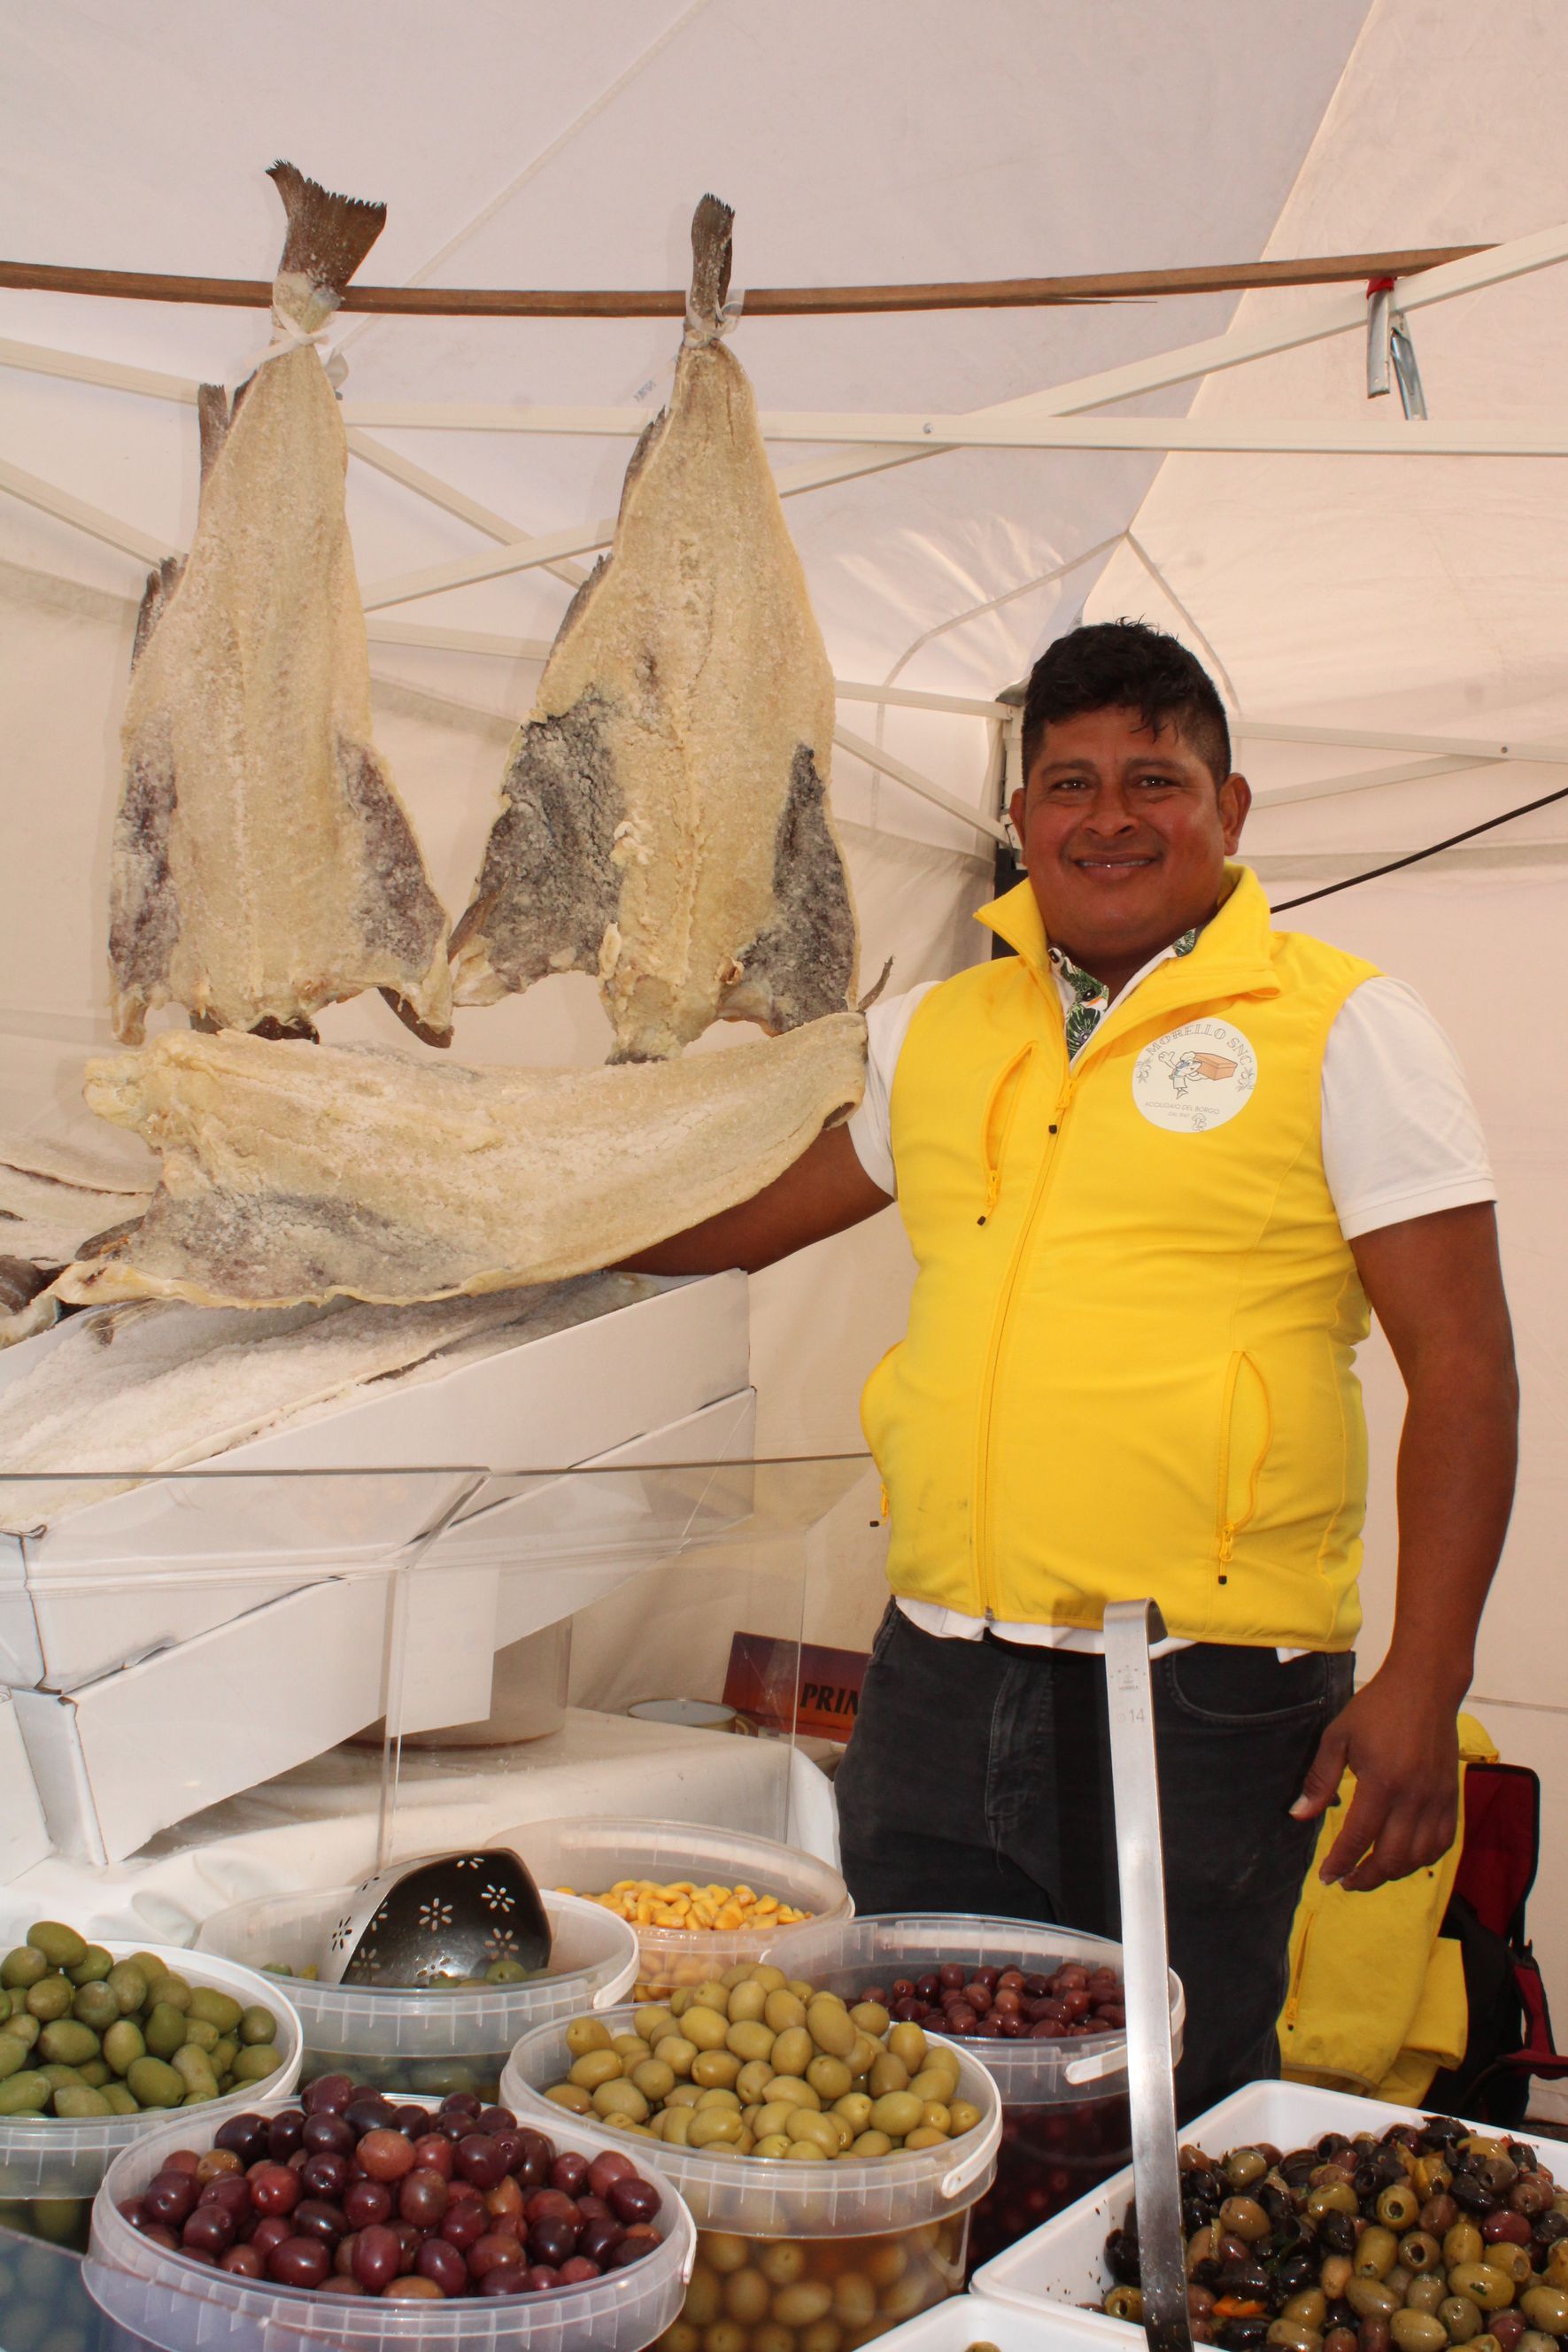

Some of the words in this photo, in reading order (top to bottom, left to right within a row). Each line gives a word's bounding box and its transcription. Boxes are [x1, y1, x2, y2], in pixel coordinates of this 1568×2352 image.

[1146, 1024, 1226, 1056] MORELLO
[1226, 1037, 1253, 1065] SNC
[1194, 1105, 1220, 1115] BORGO
[1129, 1707, 1145, 1723] 14
